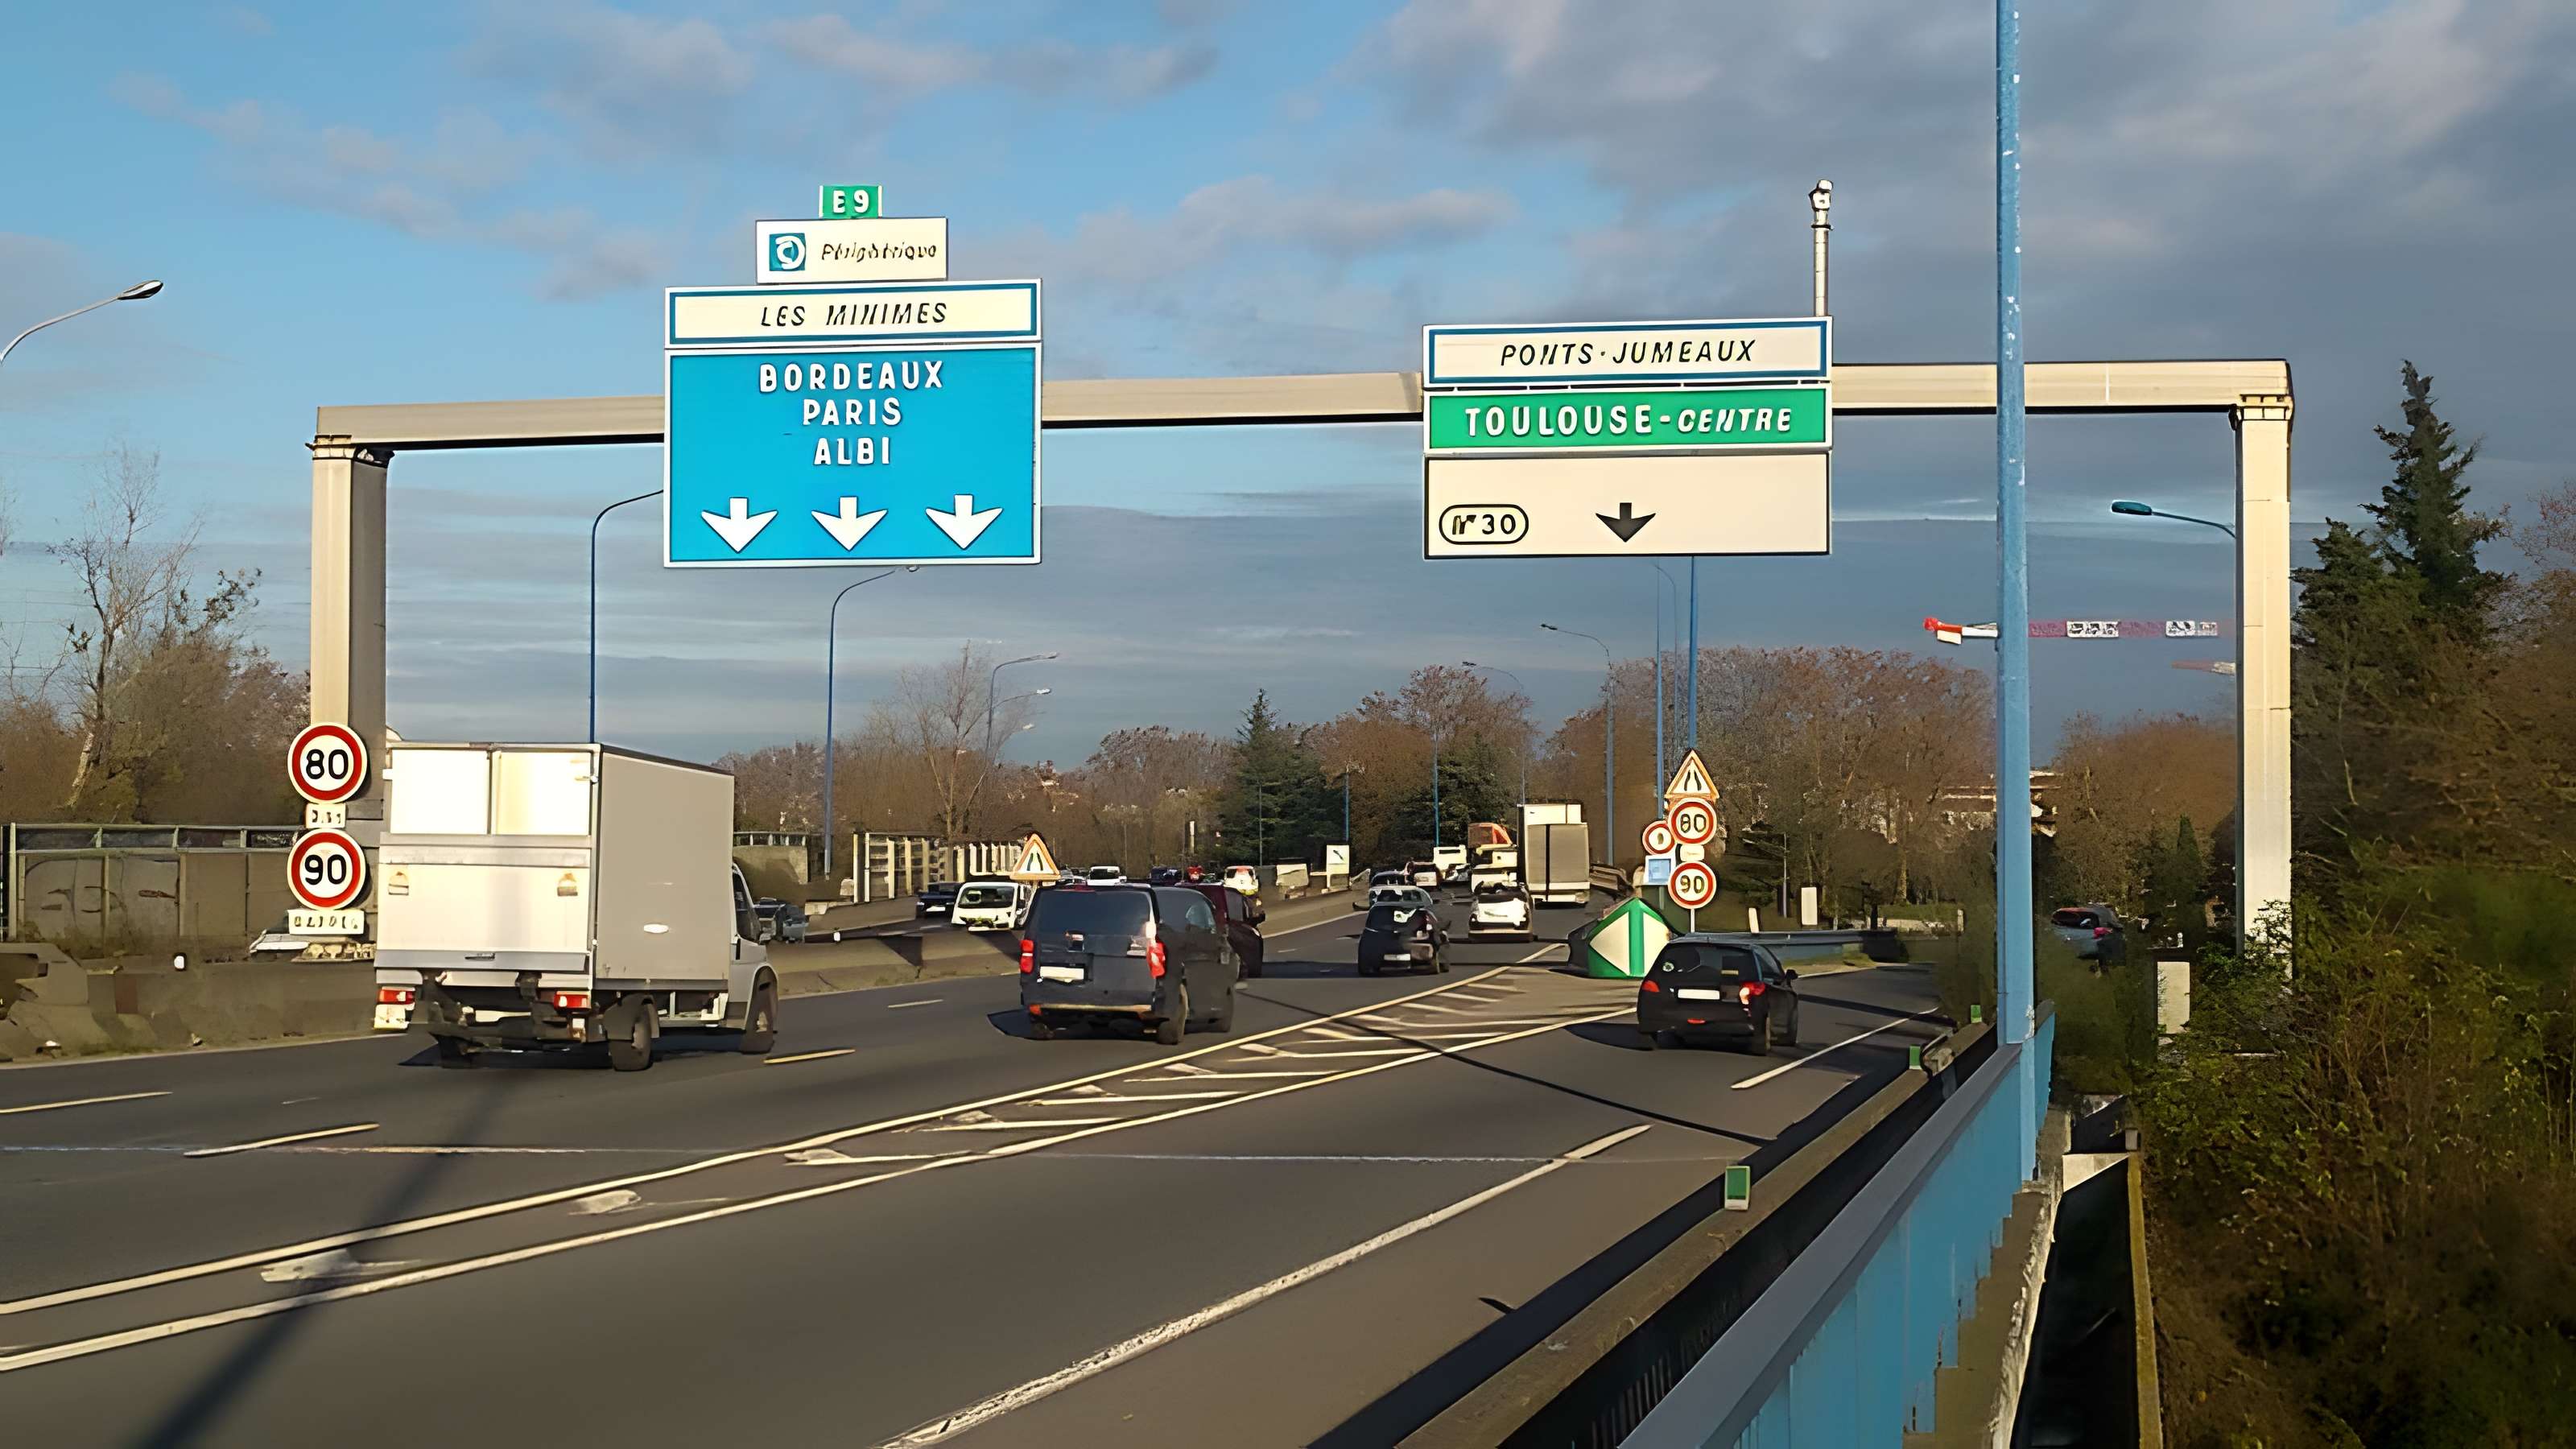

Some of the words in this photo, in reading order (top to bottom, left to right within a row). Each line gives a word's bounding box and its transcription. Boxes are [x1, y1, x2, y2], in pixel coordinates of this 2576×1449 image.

[761, 305, 806, 327] LES
[826, 302, 947, 326] MINIMES
[760, 360, 943, 392] BORDEAUX
[803, 397, 901, 426] PARIS
[814, 436, 890, 465] ALBI
[1481, 514, 1517, 535] 30
[306, 749, 349, 780] 80
[1680, 814, 1707, 833] 80
[304, 854, 347, 886] 90
[1680, 875, 1706, 894] 90
